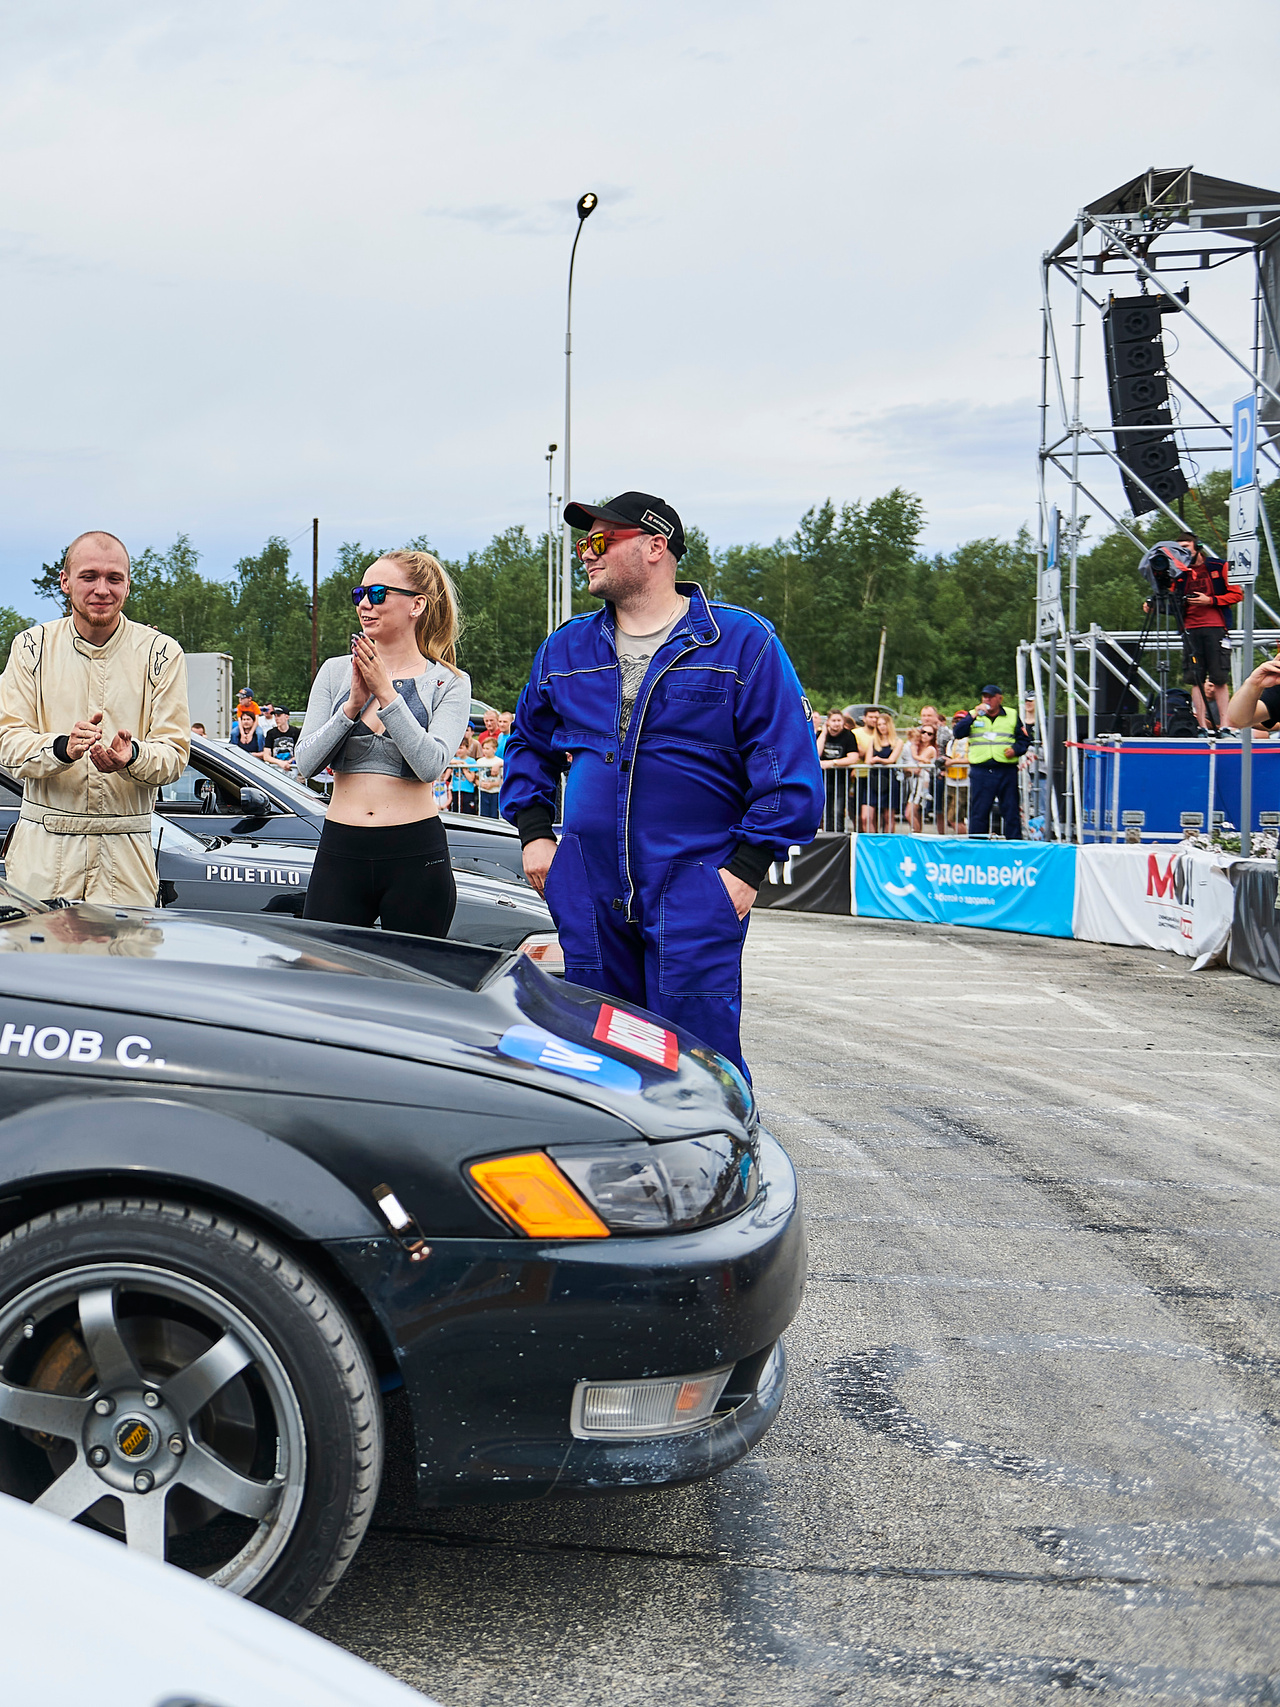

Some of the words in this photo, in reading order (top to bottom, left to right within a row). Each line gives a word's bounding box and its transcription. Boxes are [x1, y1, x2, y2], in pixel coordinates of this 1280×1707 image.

[1237, 407, 1251, 479] P
[206, 864, 300, 886] POLETILO
[925, 860, 1039, 887] эдельвейс
[115, 1034, 167, 1069] С.
